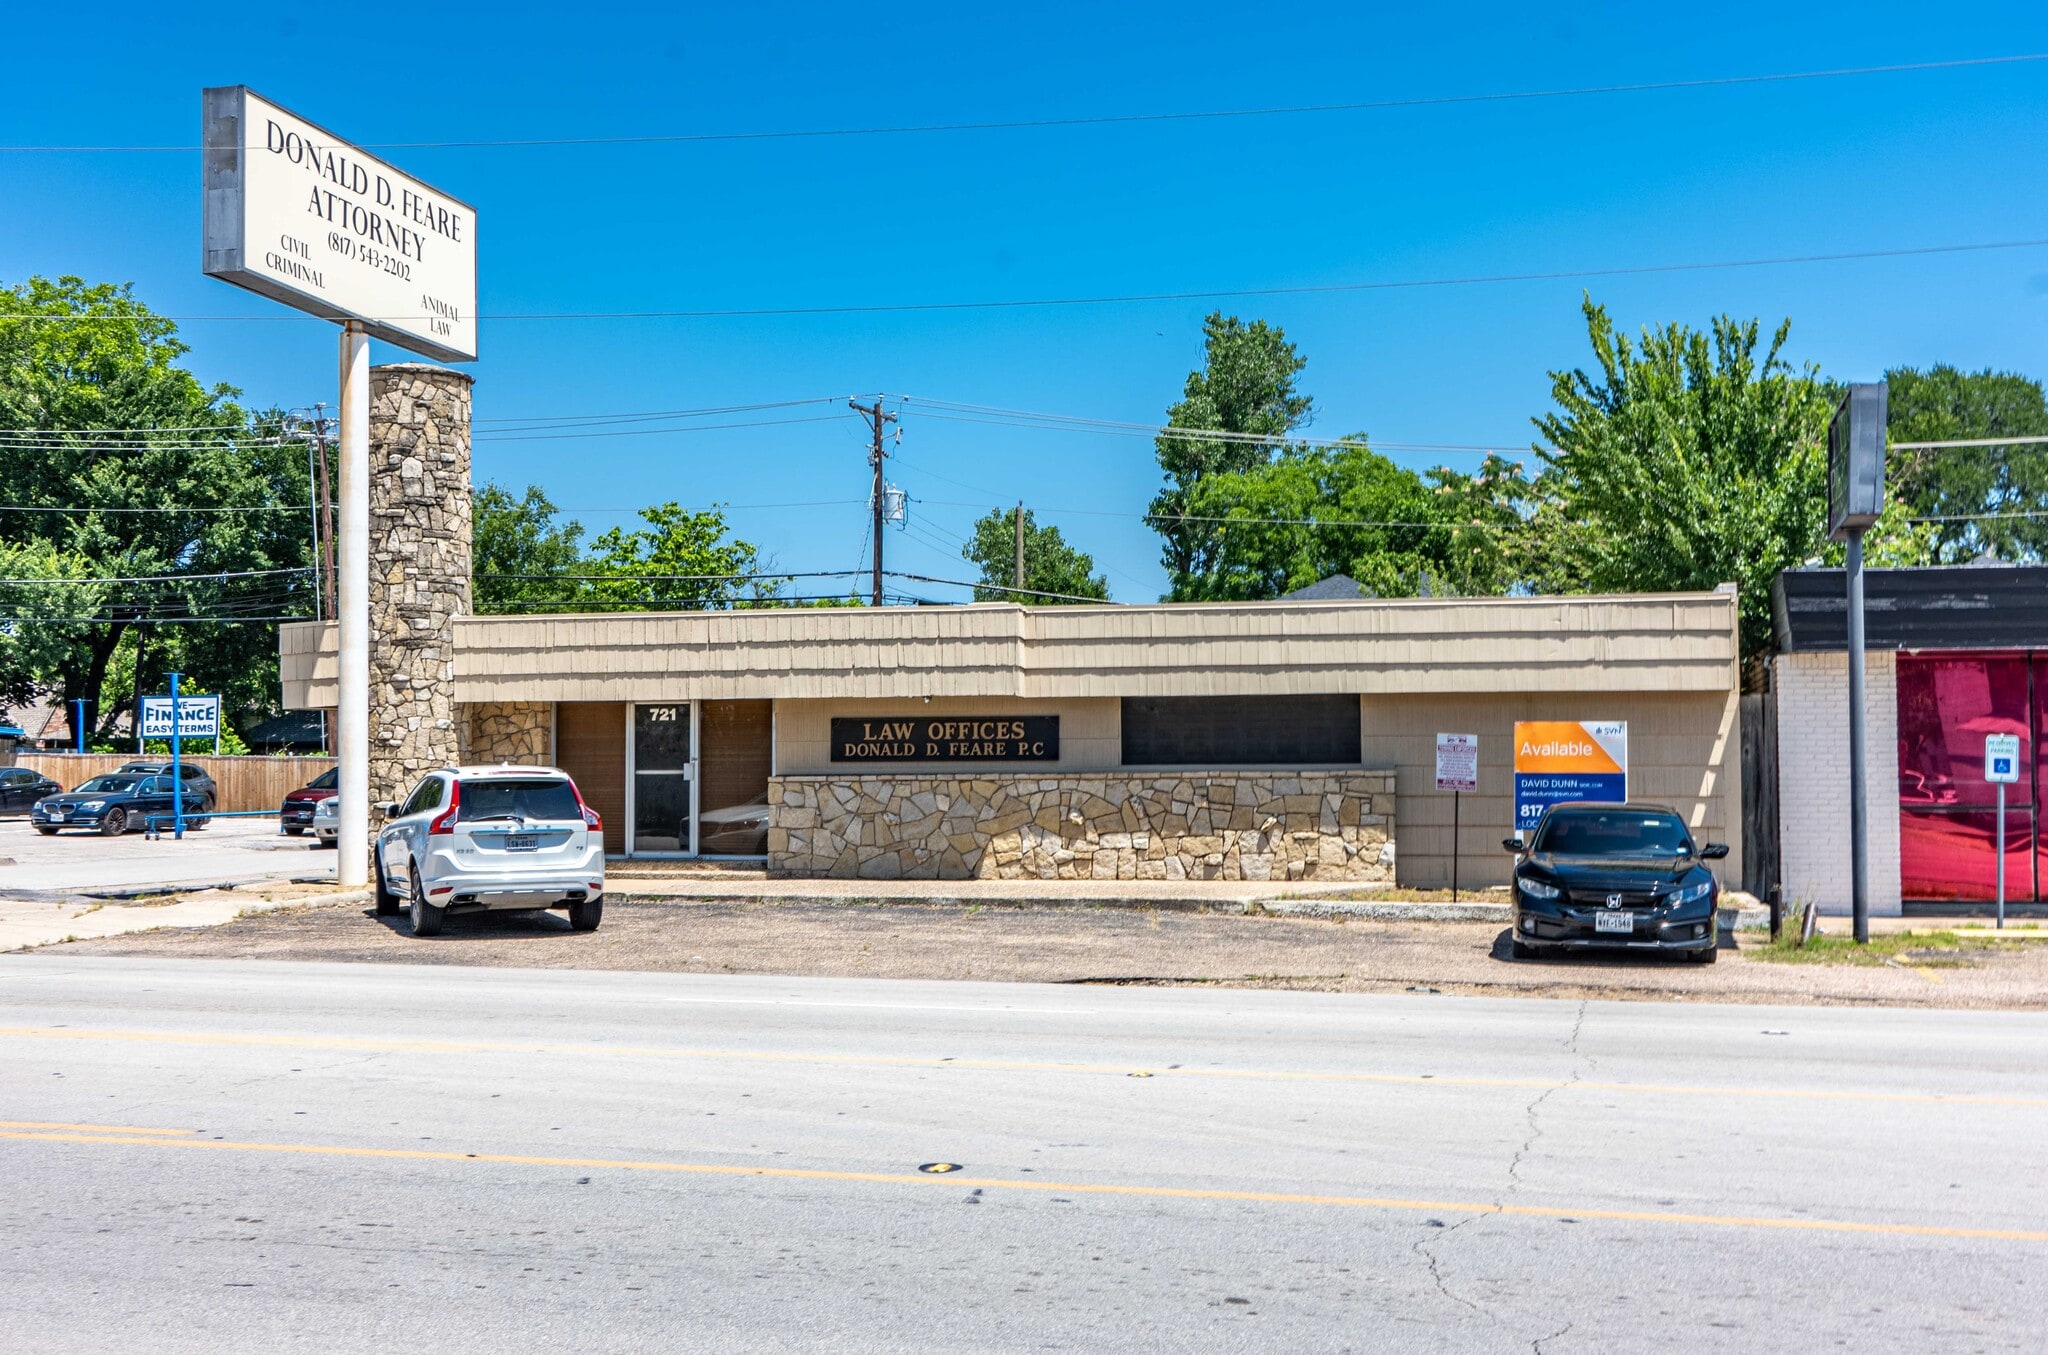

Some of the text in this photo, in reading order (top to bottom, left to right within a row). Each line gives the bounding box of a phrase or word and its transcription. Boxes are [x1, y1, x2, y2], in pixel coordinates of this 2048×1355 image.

[266, 118, 462, 243] DONALD D. FEARE
[307, 185, 426, 262] ATTORNEY
[280, 234, 312, 261] CIVIL
[327, 231, 411, 282] (817) 543-2202
[265, 252, 326, 290] CRIMINAL
[420, 293, 461, 323] ANIMAL
[430, 317, 452, 337] LAW
[145, 706, 215, 721] FINANCE
[649, 708, 676, 721] 721
[146, 724, 214, 733] EASY TERMS
[864, 722, 1026, 741] LAW OFFICES
[844, 742, 916, 757] DONALD
[926, 742, 941, 757] D.
[948, 742, 1007, 757] FEARE
[1520, 741, 1593, 757] Available
[1521, 779, 1549, 788] DAVID
[1551, 779, 1578, 788] DUNN
